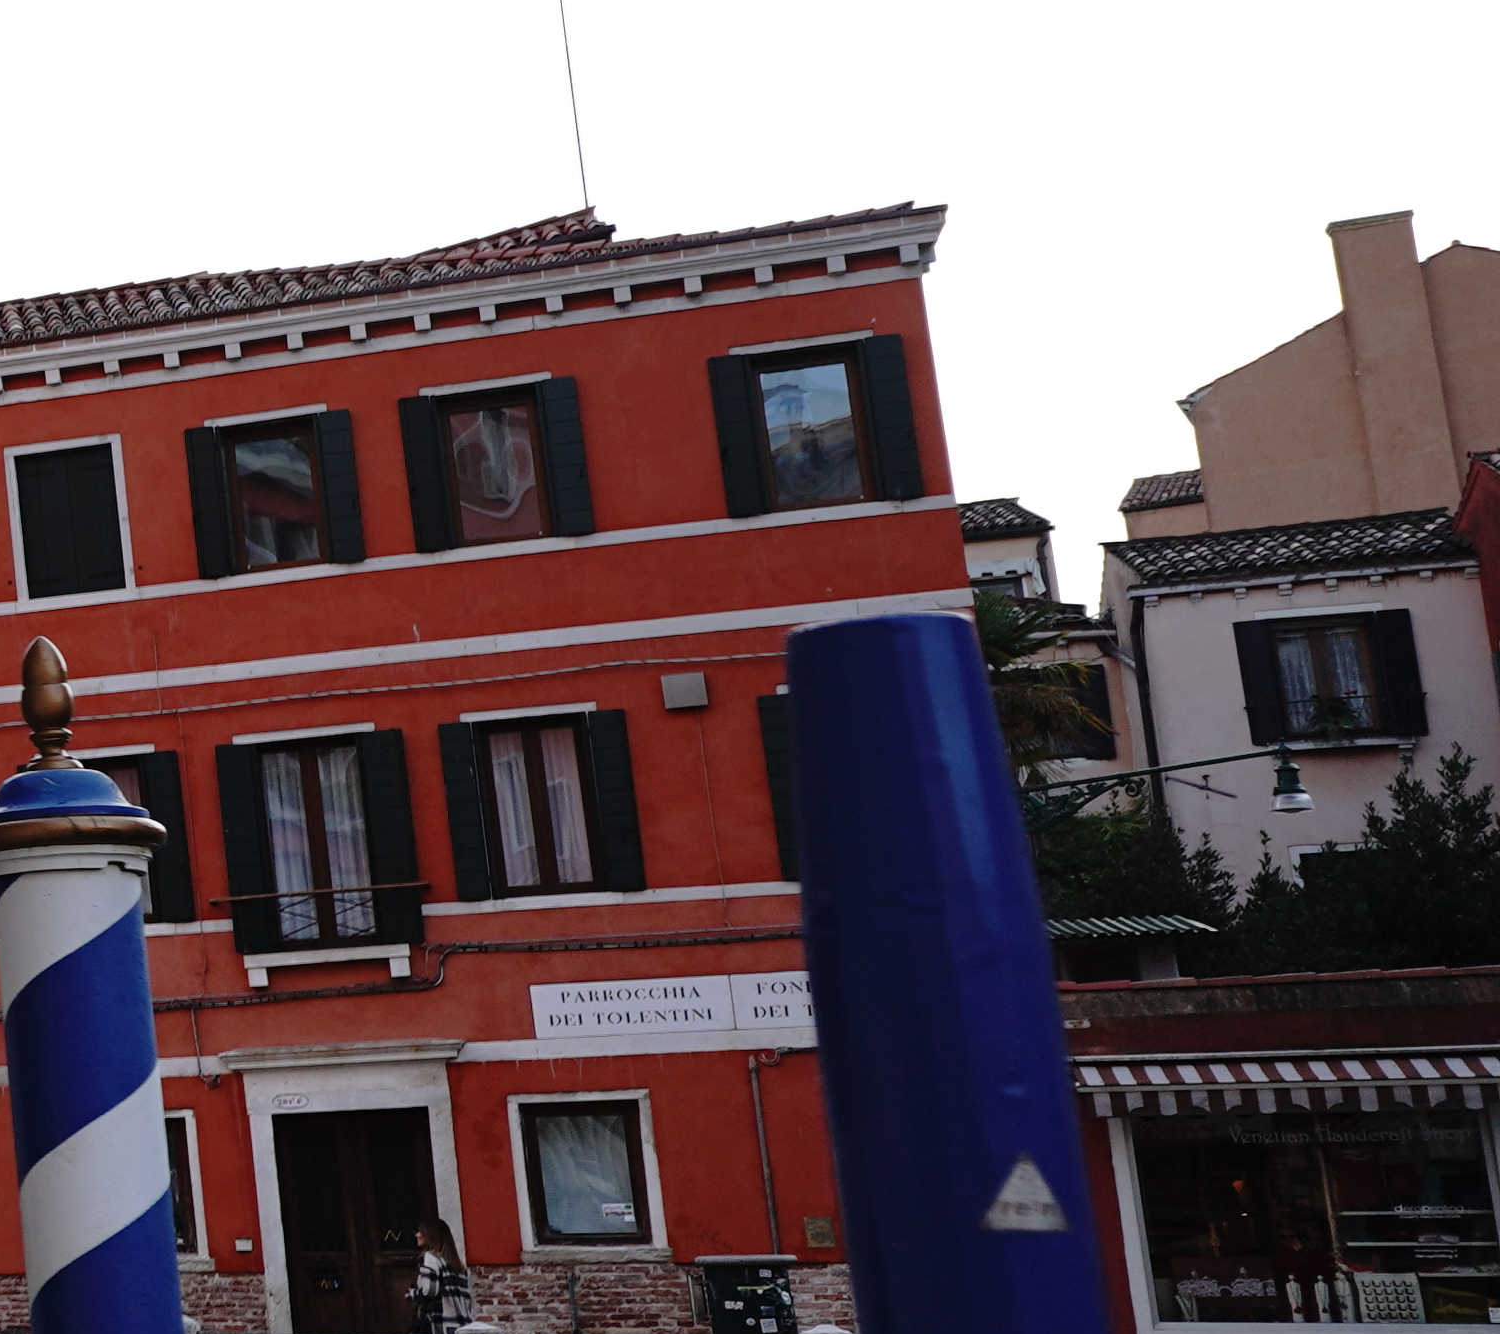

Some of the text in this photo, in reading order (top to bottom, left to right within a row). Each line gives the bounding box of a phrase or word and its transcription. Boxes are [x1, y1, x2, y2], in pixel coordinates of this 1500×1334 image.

[560, 985, 701, 1004] PARROCCHIA
[549, 1013, 583, 1027] DEI
[592, 1007, 713, 1026] TOLENTINI
[753, 1005, 789, 1019] DEI
[1229, 1124, 1310, 1144] Venetian
[1315, 1123, 1412, 1145] Handcraft
[1418, 1122, 1471, 1144] Shop
